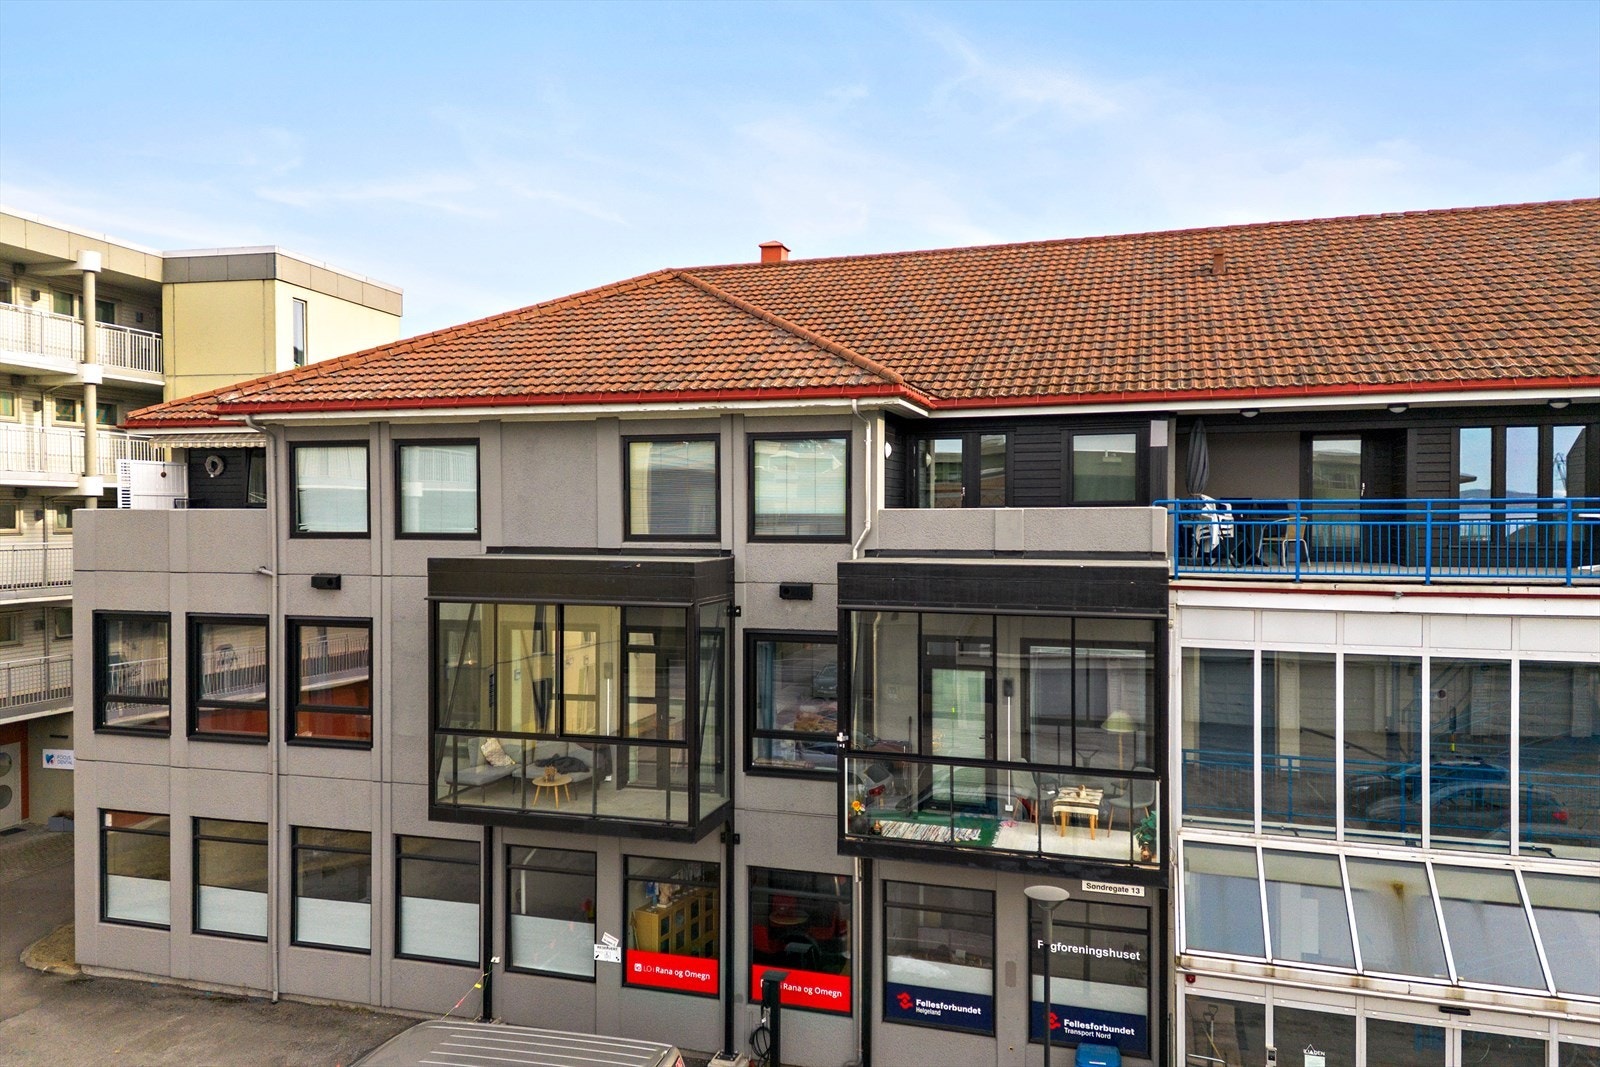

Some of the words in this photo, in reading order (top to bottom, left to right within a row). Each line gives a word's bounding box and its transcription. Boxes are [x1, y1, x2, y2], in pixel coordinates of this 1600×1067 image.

[1131, 887, 1141, 895] 13
[1037, 939, 1141, 961] Fgforeningshuset
[655, 966, 673, 975] Rana
[674, 970, 684, 979] og
[684, 970, 710, 981] Omegn
[783, 982, 802, 992] Rana
[803, 987, 813, 996] og
[814, 986, 842, 998] Omegn
[915, 999, 982, 1015] Fellesforbundet
[915, 1007, 942, 1016] Helgeland
[1063, 1018, 1135, 1036] Fellesforbundet
[1064, 1027, 1095, 1038] Transport
[1095, 1031, 1112, 1040] Nord
